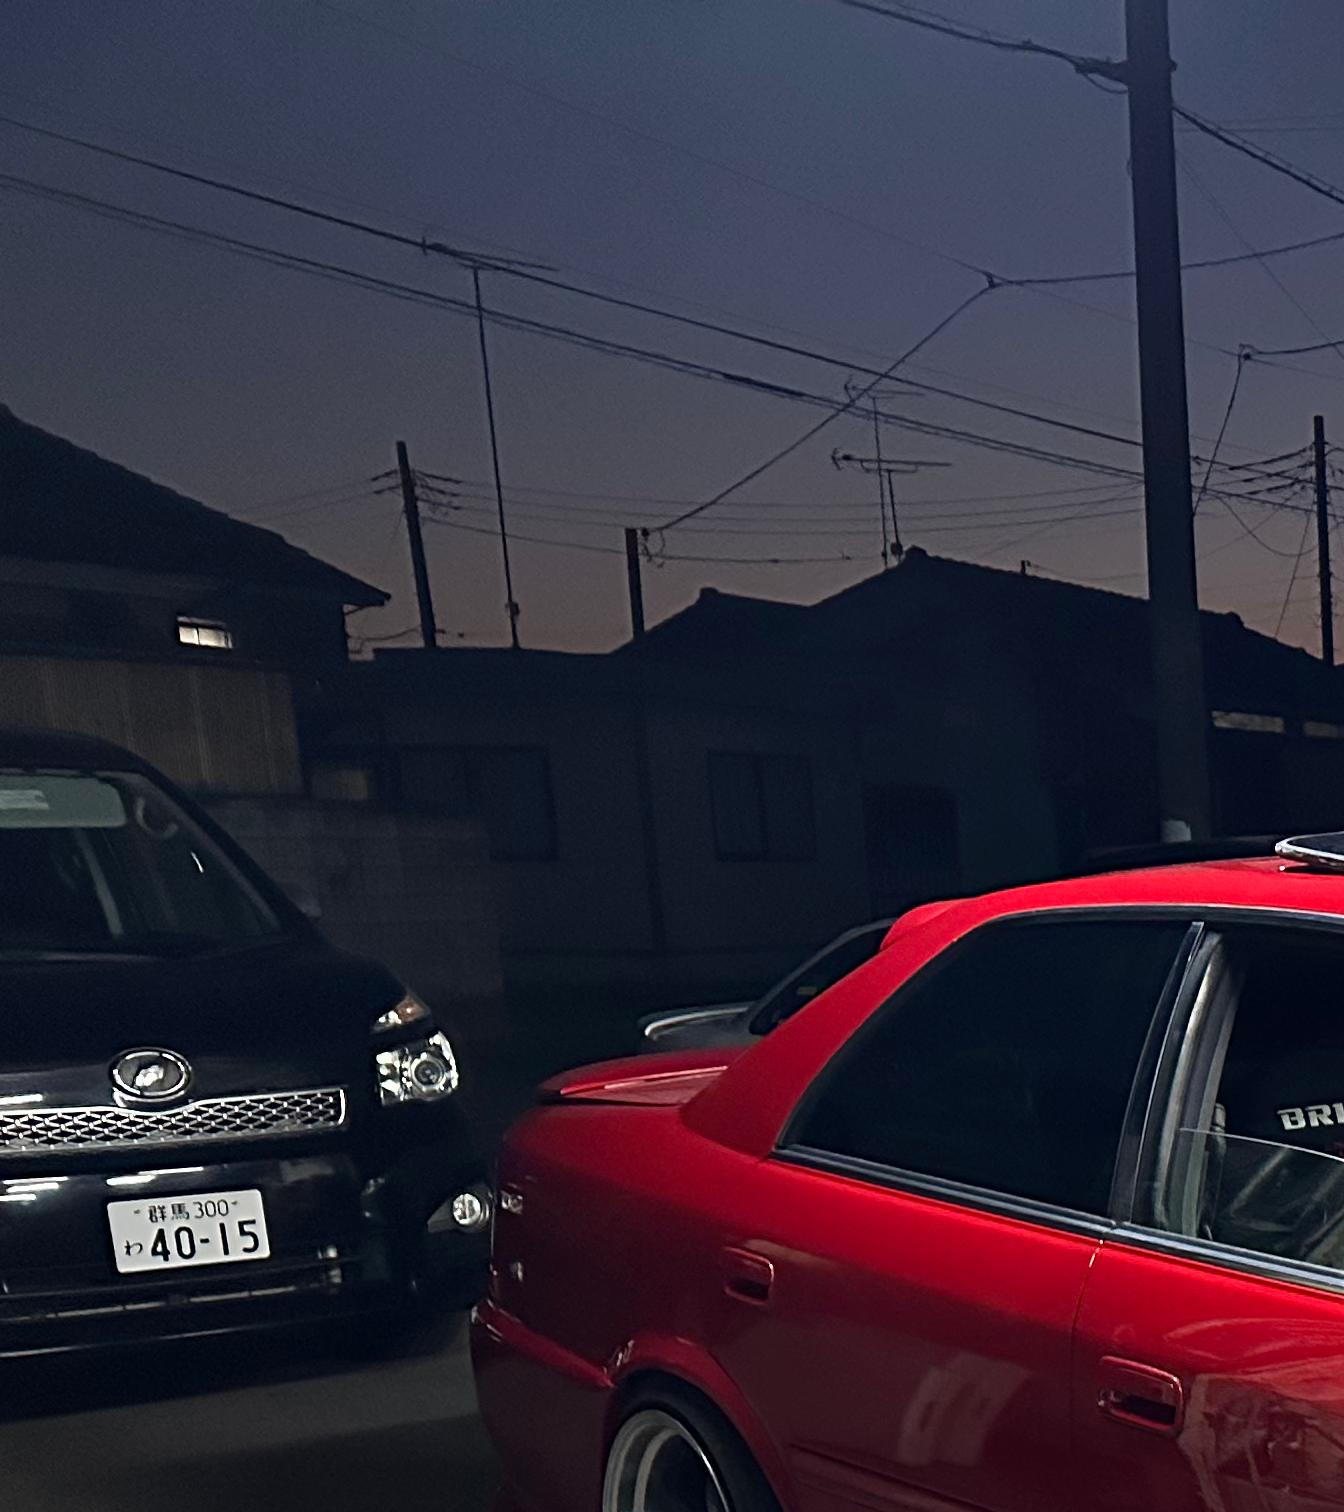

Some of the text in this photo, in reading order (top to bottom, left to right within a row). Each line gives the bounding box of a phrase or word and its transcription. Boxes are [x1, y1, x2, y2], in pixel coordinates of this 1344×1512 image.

[193, 1199, 229, 1219] 300
[124, 1219, 260, 1262] わ 40-15
